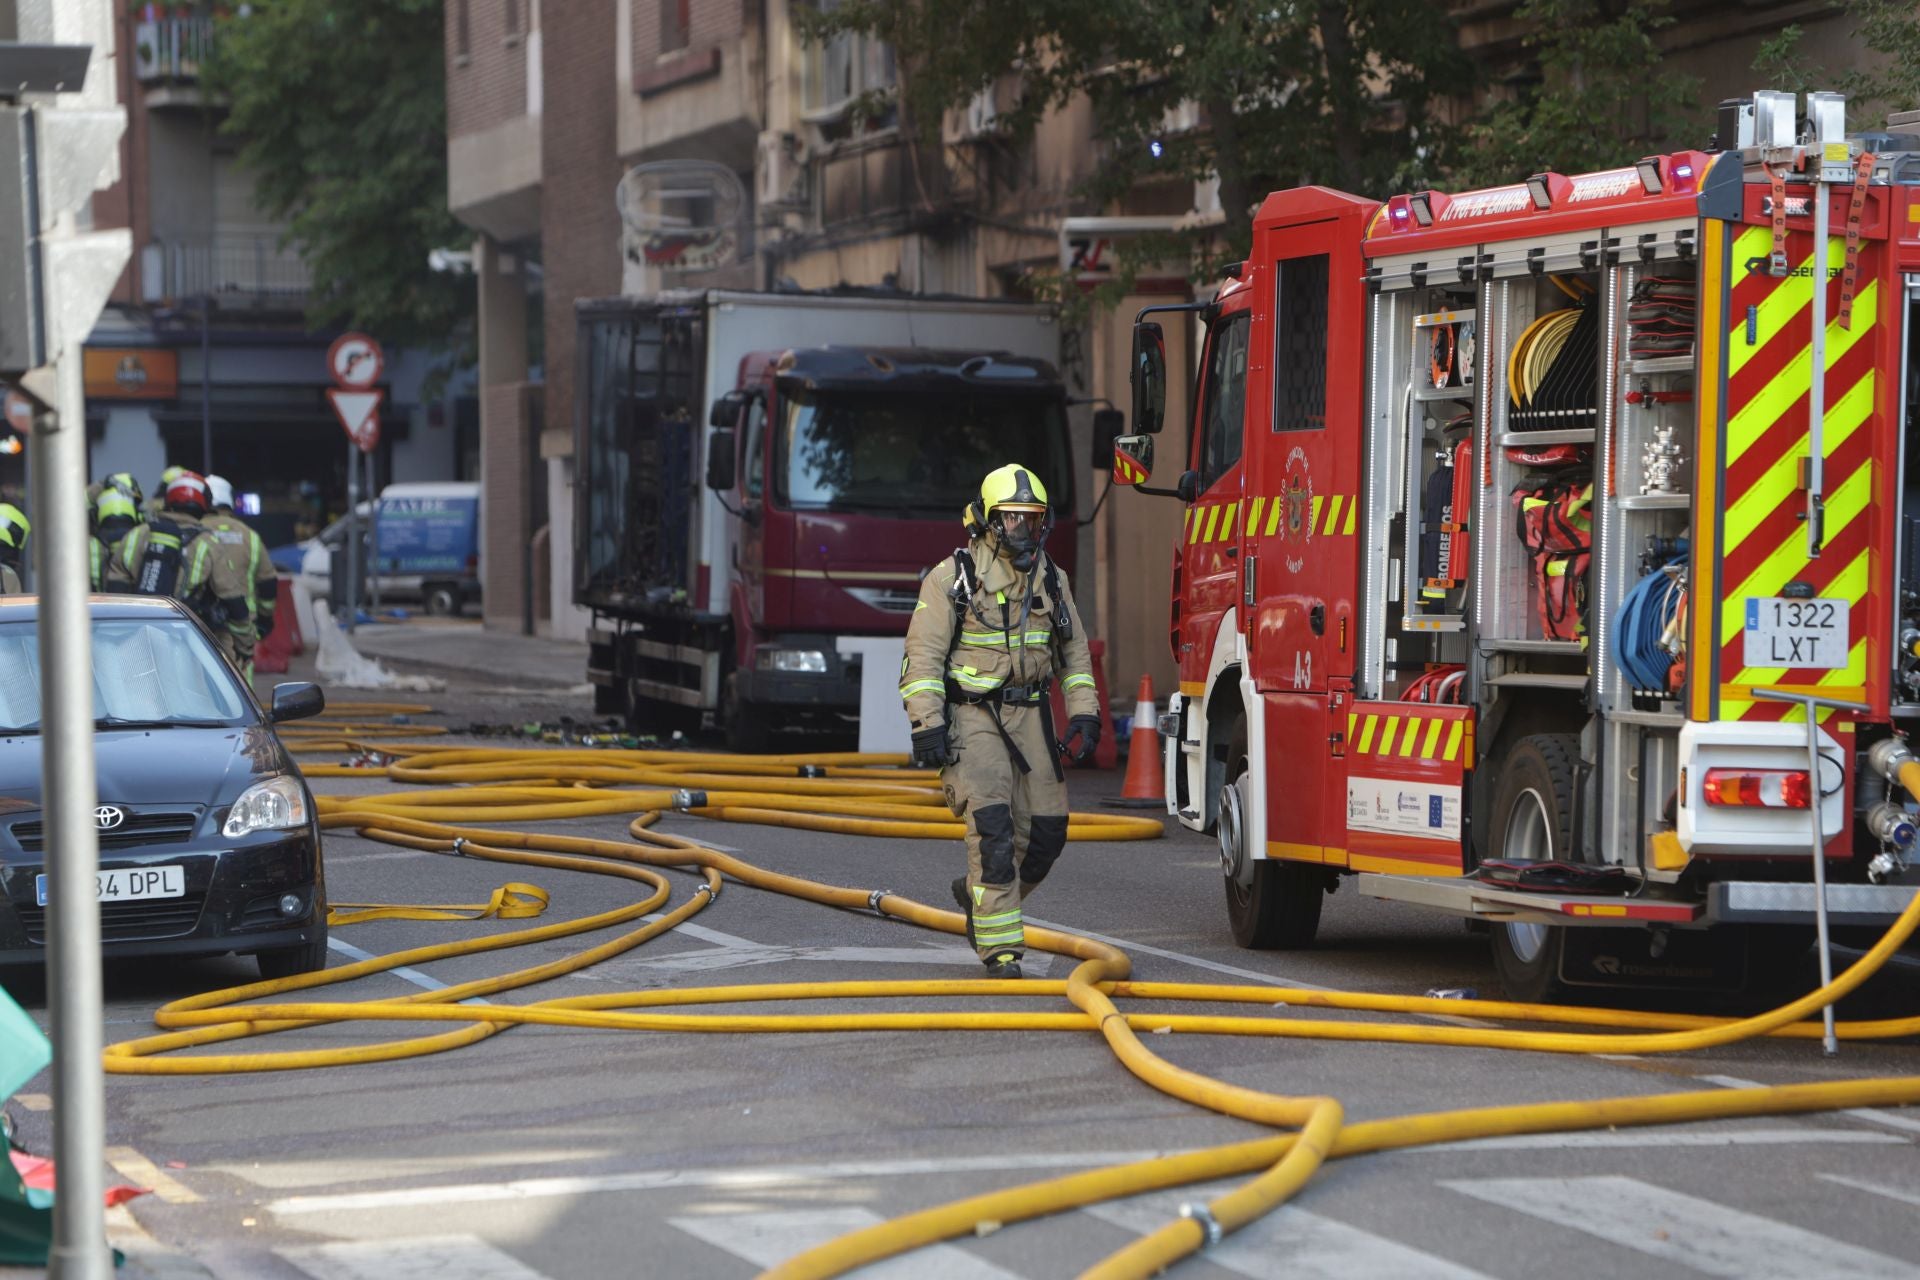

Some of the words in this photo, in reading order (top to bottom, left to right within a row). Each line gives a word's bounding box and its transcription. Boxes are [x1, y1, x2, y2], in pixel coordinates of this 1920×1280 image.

[1438, 505, 1453, 580] BOMBEOS
[1774, 603, 1835, 628] 1322
[1771, 636, 1820, 662] LXT
[130, 870, 177, 896] DPL
